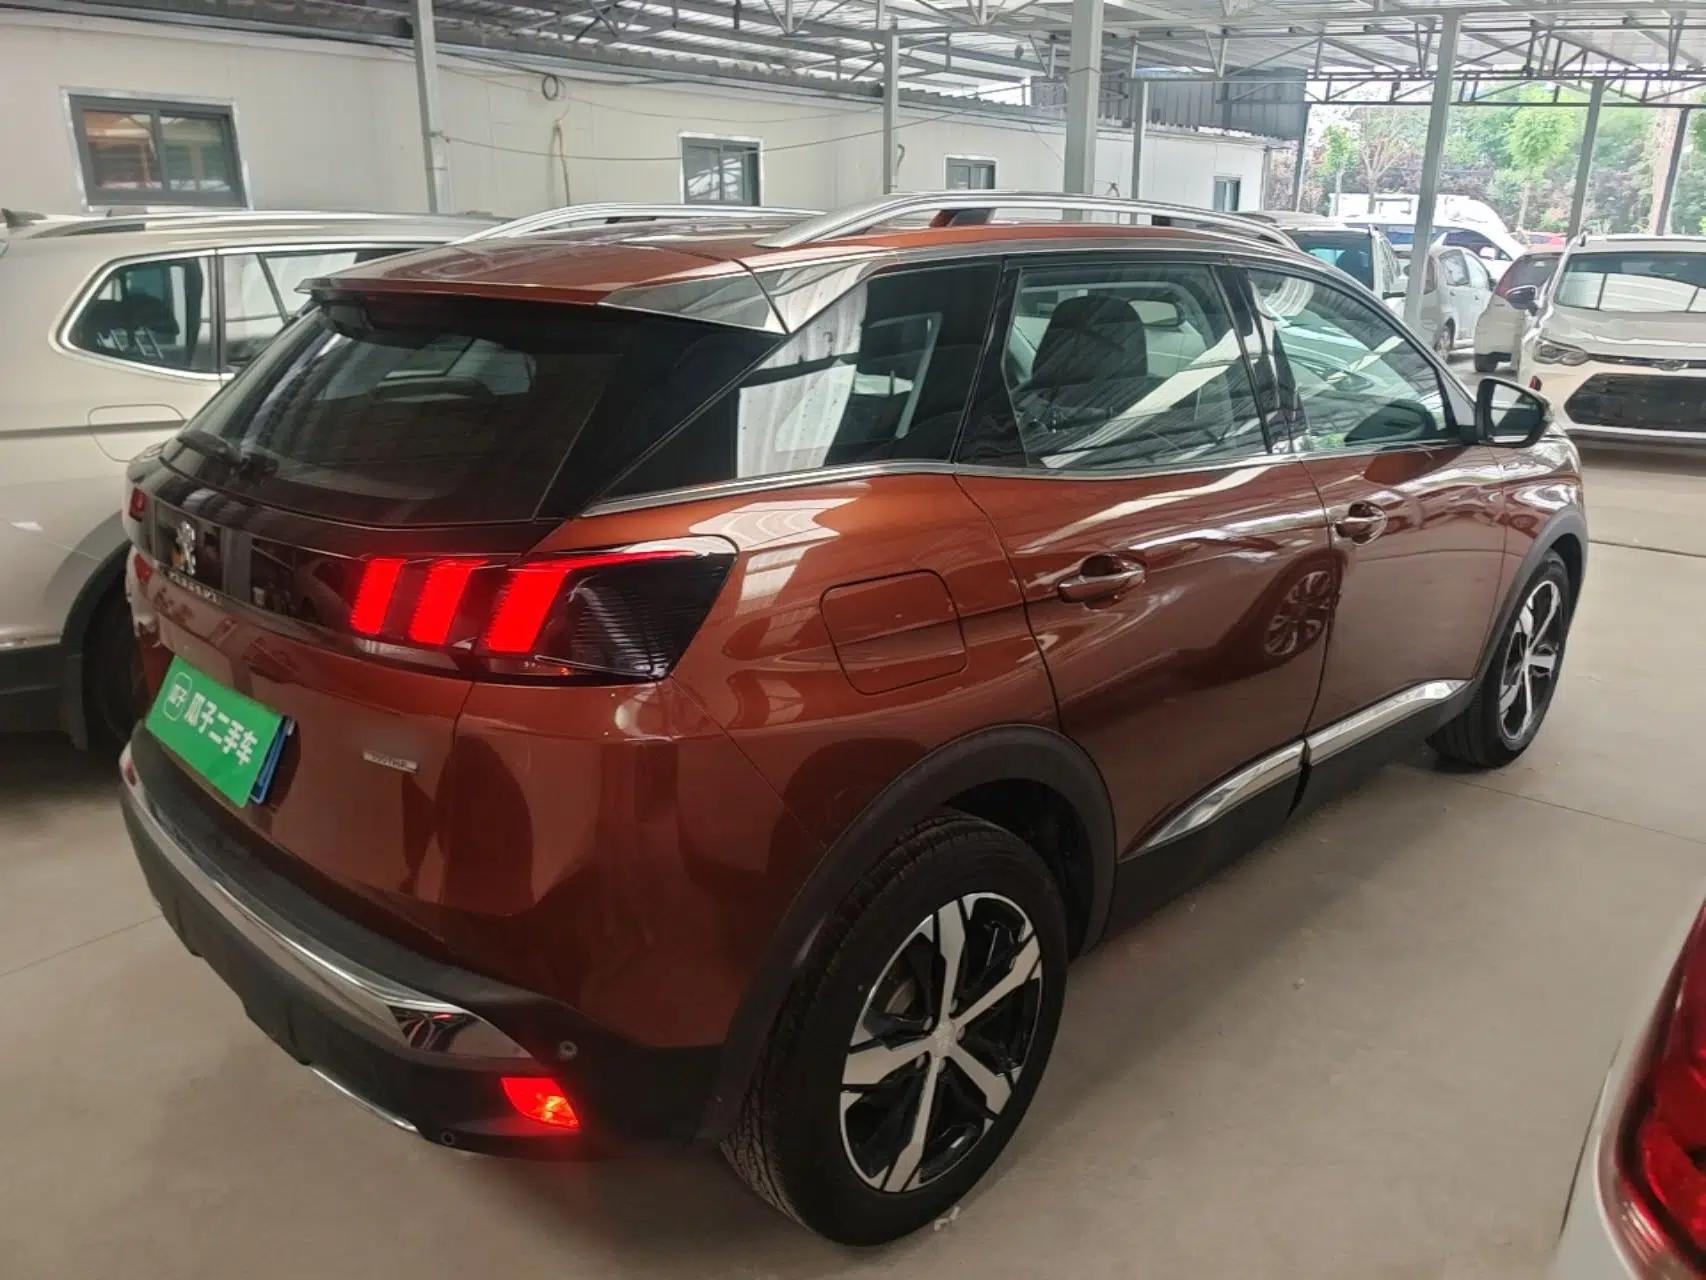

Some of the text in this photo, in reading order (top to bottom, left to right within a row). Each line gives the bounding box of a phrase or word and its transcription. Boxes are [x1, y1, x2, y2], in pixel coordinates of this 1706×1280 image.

[184, 692, 258, 766] 瓜子二手车
